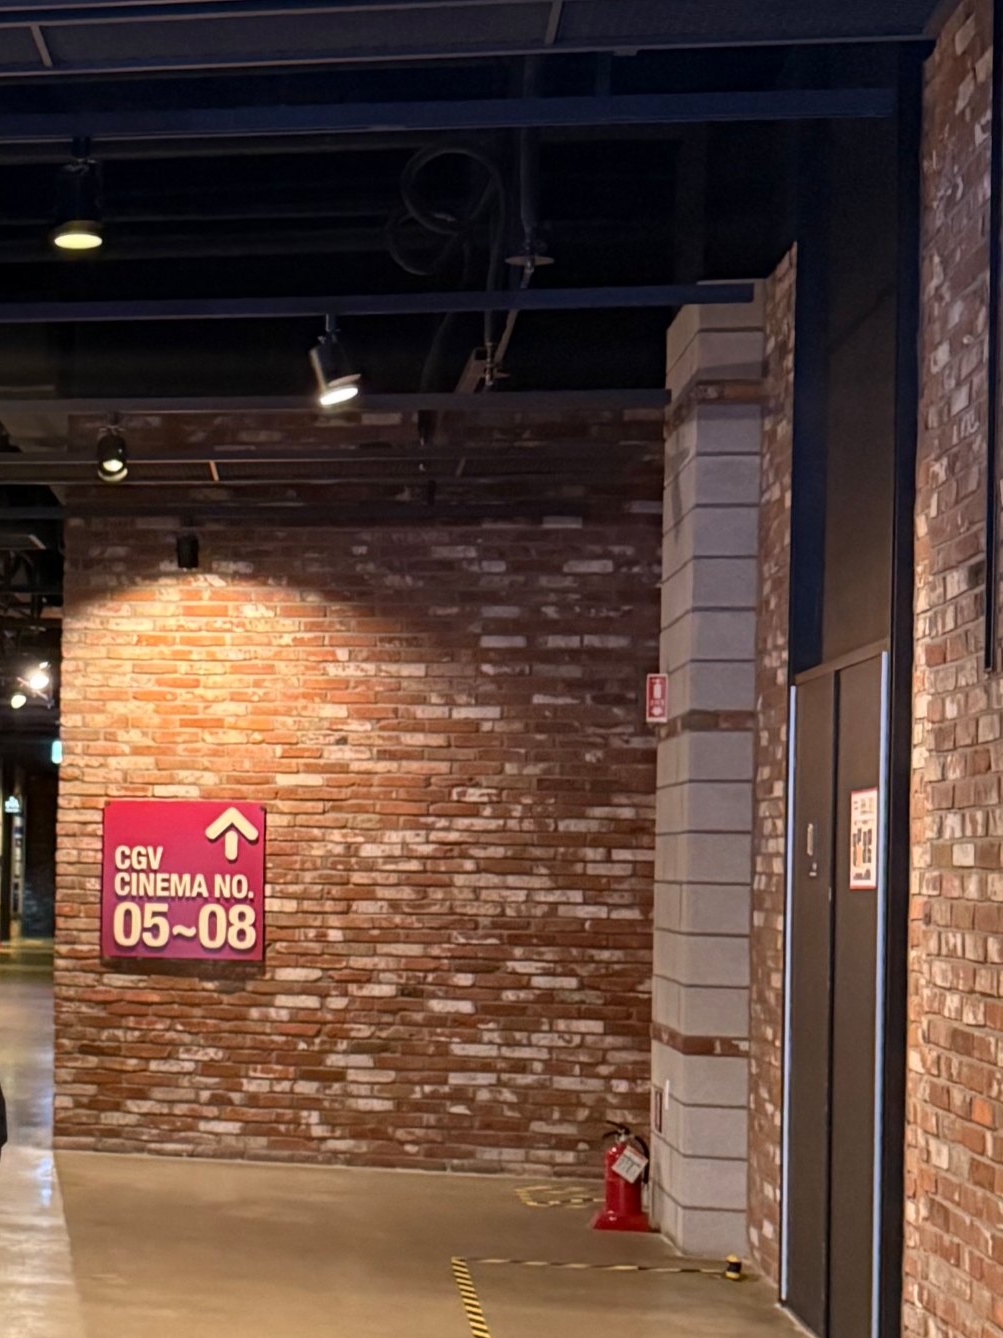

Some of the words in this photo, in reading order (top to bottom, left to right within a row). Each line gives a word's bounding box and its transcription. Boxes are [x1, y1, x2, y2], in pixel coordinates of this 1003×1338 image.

[114, 845, 164, 870] CGV
[114, 872, 209, 898] CINEMA
[214, 874, 254, 899] NO.
[113, 901, 257, 950] 05~08
